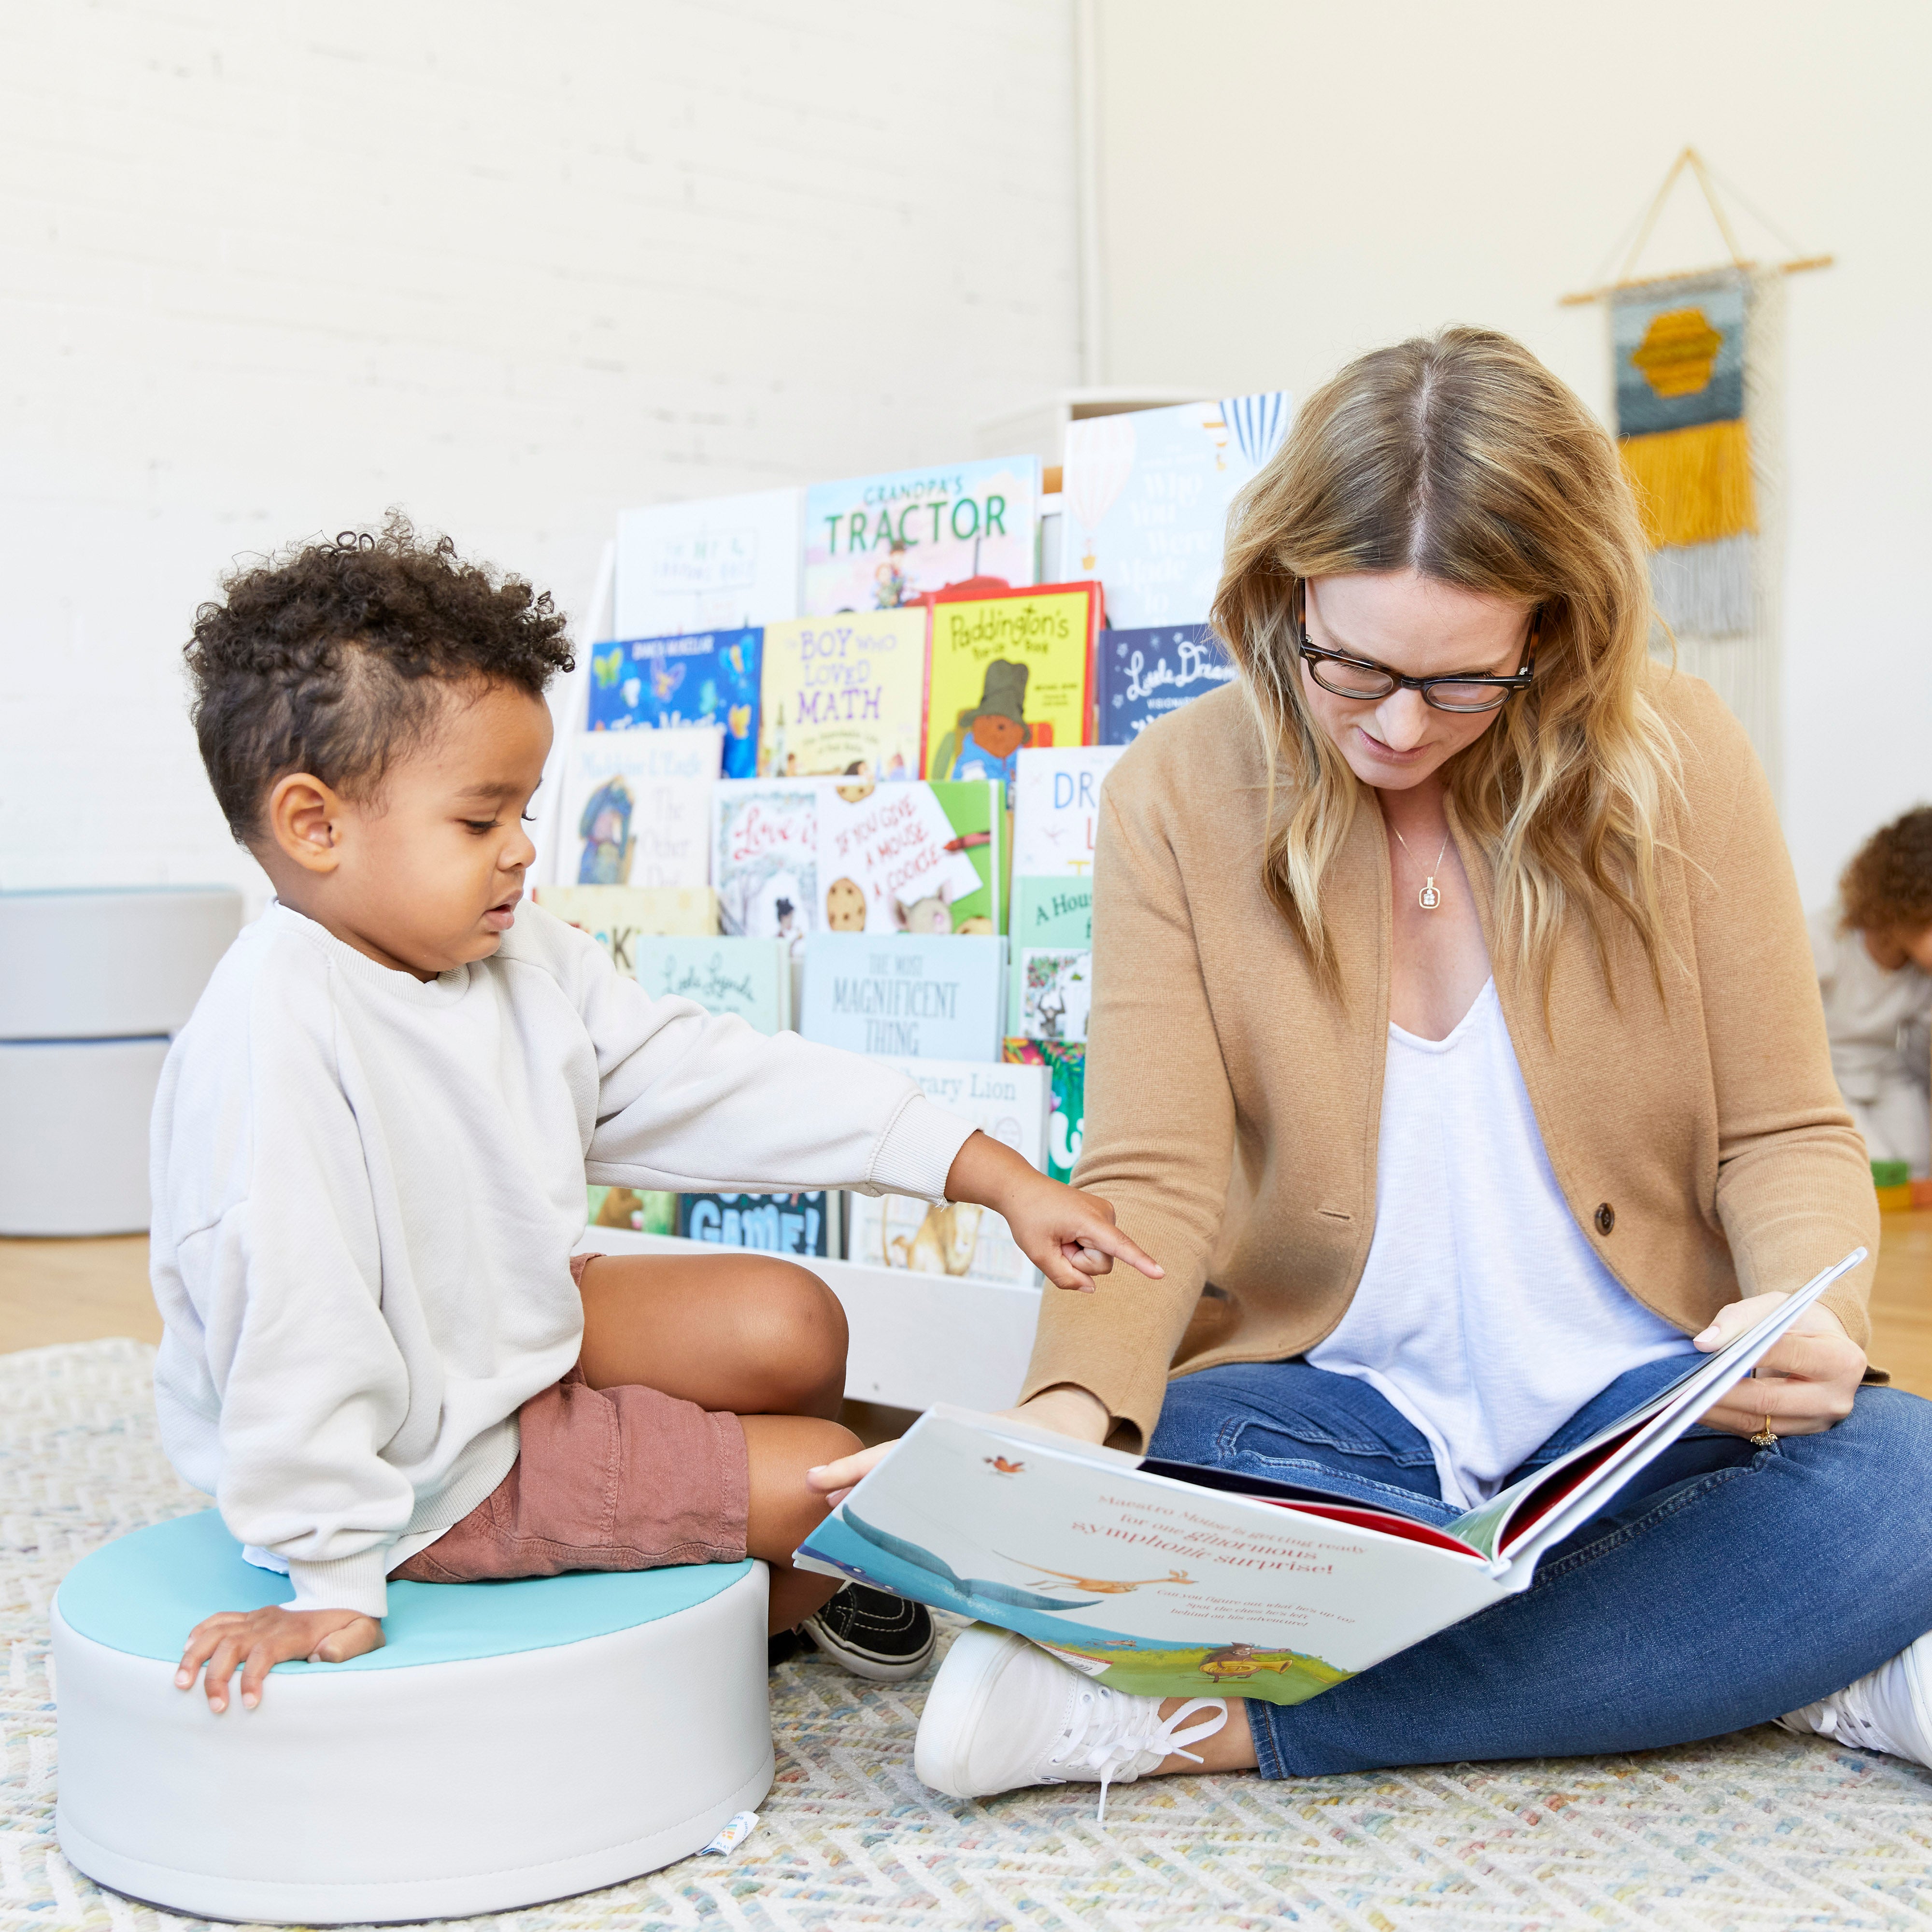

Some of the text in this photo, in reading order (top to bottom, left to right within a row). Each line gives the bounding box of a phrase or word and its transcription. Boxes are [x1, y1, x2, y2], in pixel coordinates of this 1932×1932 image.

[864, 474, 964, 506] GRANDPA'S
[822, 494, 1007, 556] TRACTOR
[800, 627, 853, 661] BOY
[951, 604, 1069, 651] Paddington's
[804, 658, 871, 687] LOVED
[796, 685, 882, 724] MATH
[1054, 771, 1095, 810] DR
[733, 806, 795, 860] Love
[853, 811, 878, 843] YOU
[880, 793, 917, 828] GIVE
[865, 819, 929, 871] A MOUSE
[873, 843, 940, 902] A COOKIE
[1036, 905, 1050, 926] A
[868, 952, 923, 977] THE MOST
[831, 976, 960, 1020] MAGNIFICENT
[865, 1017, 920, 1057] THING
[904, 1067, 1016, 1102] rary Lion
[690, 1199, 820, 1256] GAME!
[1098, 1495, 1368, 1554] Maestro Mouse is getting ready
[1120, 1513, 1318, 1560] for one ginormous
[1071, 1521, 1334, 1574] symphonic surprise!
[1157, 1589, 1179, 1597] Can
[1205, 1596, 1241, 1605] figure
[1295, 1605, 1317, 1613] he's
[1170, 1608, 1209, 1618] behind
[1246, 1616, 1308, 1627] adventure!
